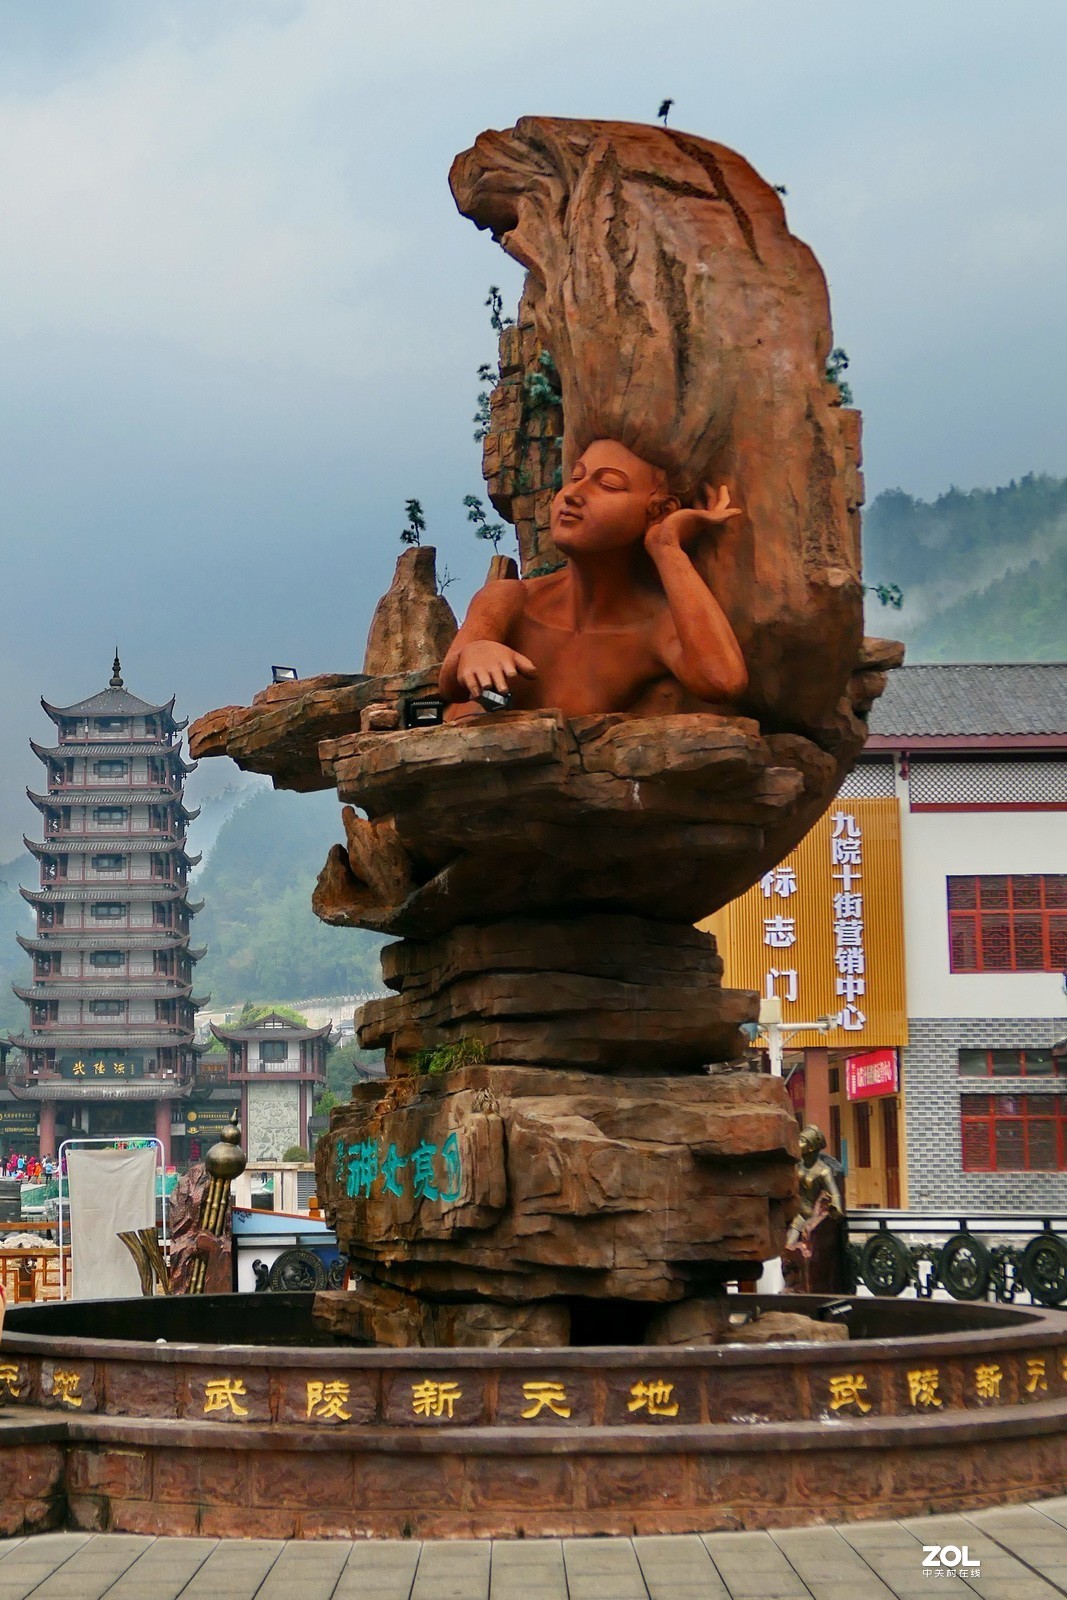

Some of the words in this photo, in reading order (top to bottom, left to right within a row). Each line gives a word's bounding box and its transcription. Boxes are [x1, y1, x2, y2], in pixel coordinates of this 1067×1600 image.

[830, 811, 867, 1031] 九院十街营销中心
[72, 1060, 125, 1076] 武陵源
[203, 1378, 680, 1420] 武陵新天地
[829, 1358, 1067, 1413] 武陵新天
